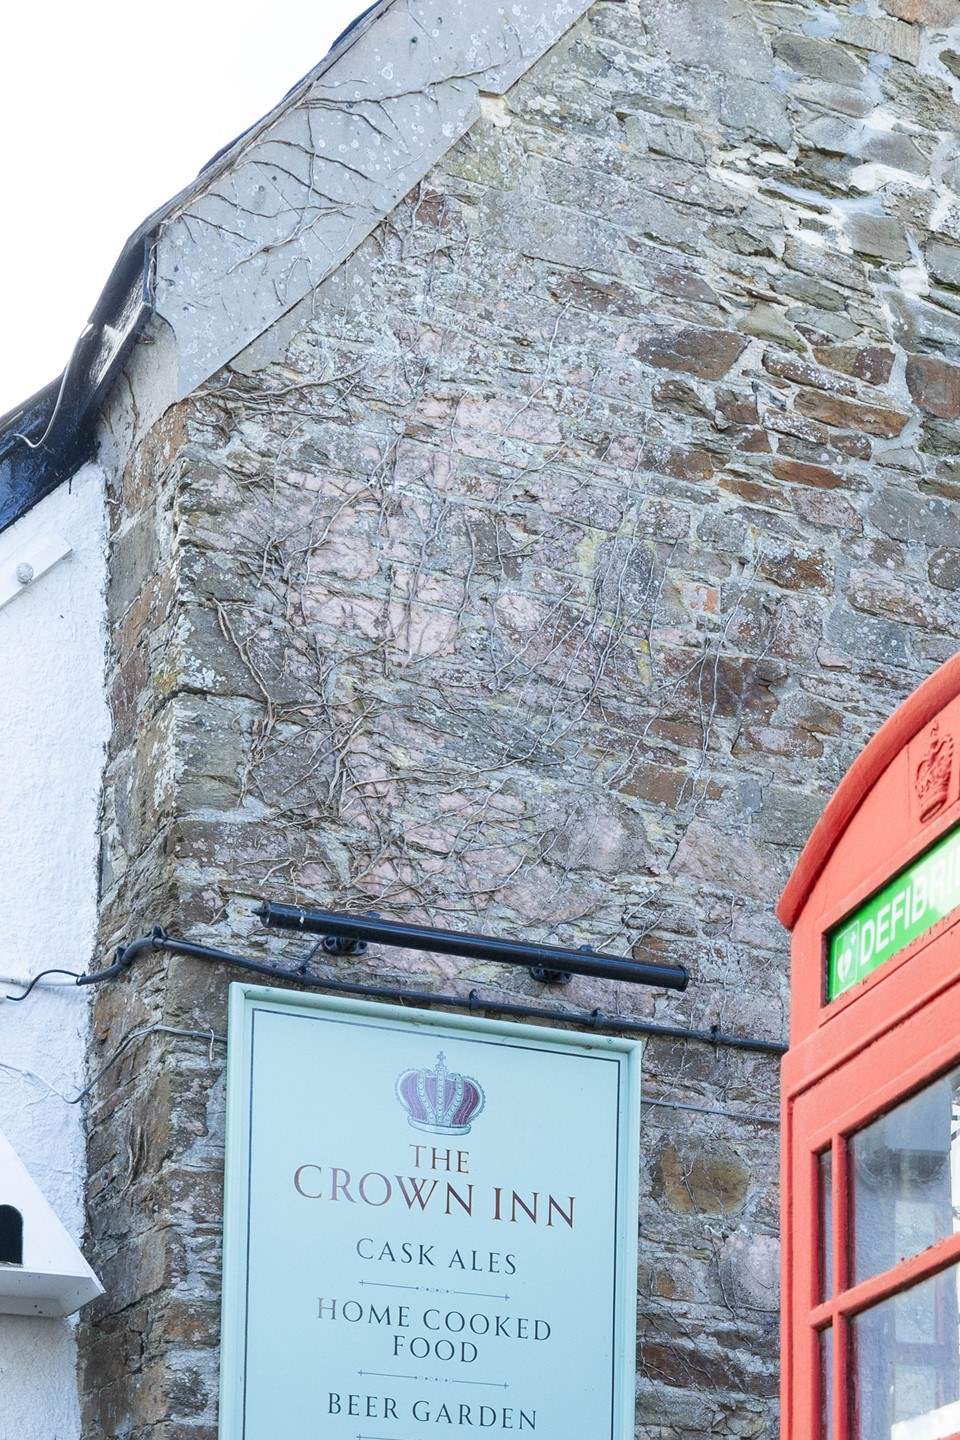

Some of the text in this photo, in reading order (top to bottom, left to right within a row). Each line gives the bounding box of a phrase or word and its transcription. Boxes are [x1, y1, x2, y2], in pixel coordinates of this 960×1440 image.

[409, 1143, 470, 1175] THE
[293, 1164, 577, 1229] CROWN INN
[356, 1237, 518, 1276] CASK ALES
[316, 1298, 552, 1342] HOME COOKED
[392, 1335, 479, 1364] FOOD
[327, 1392, 539, 1431] BEER GARDEN
